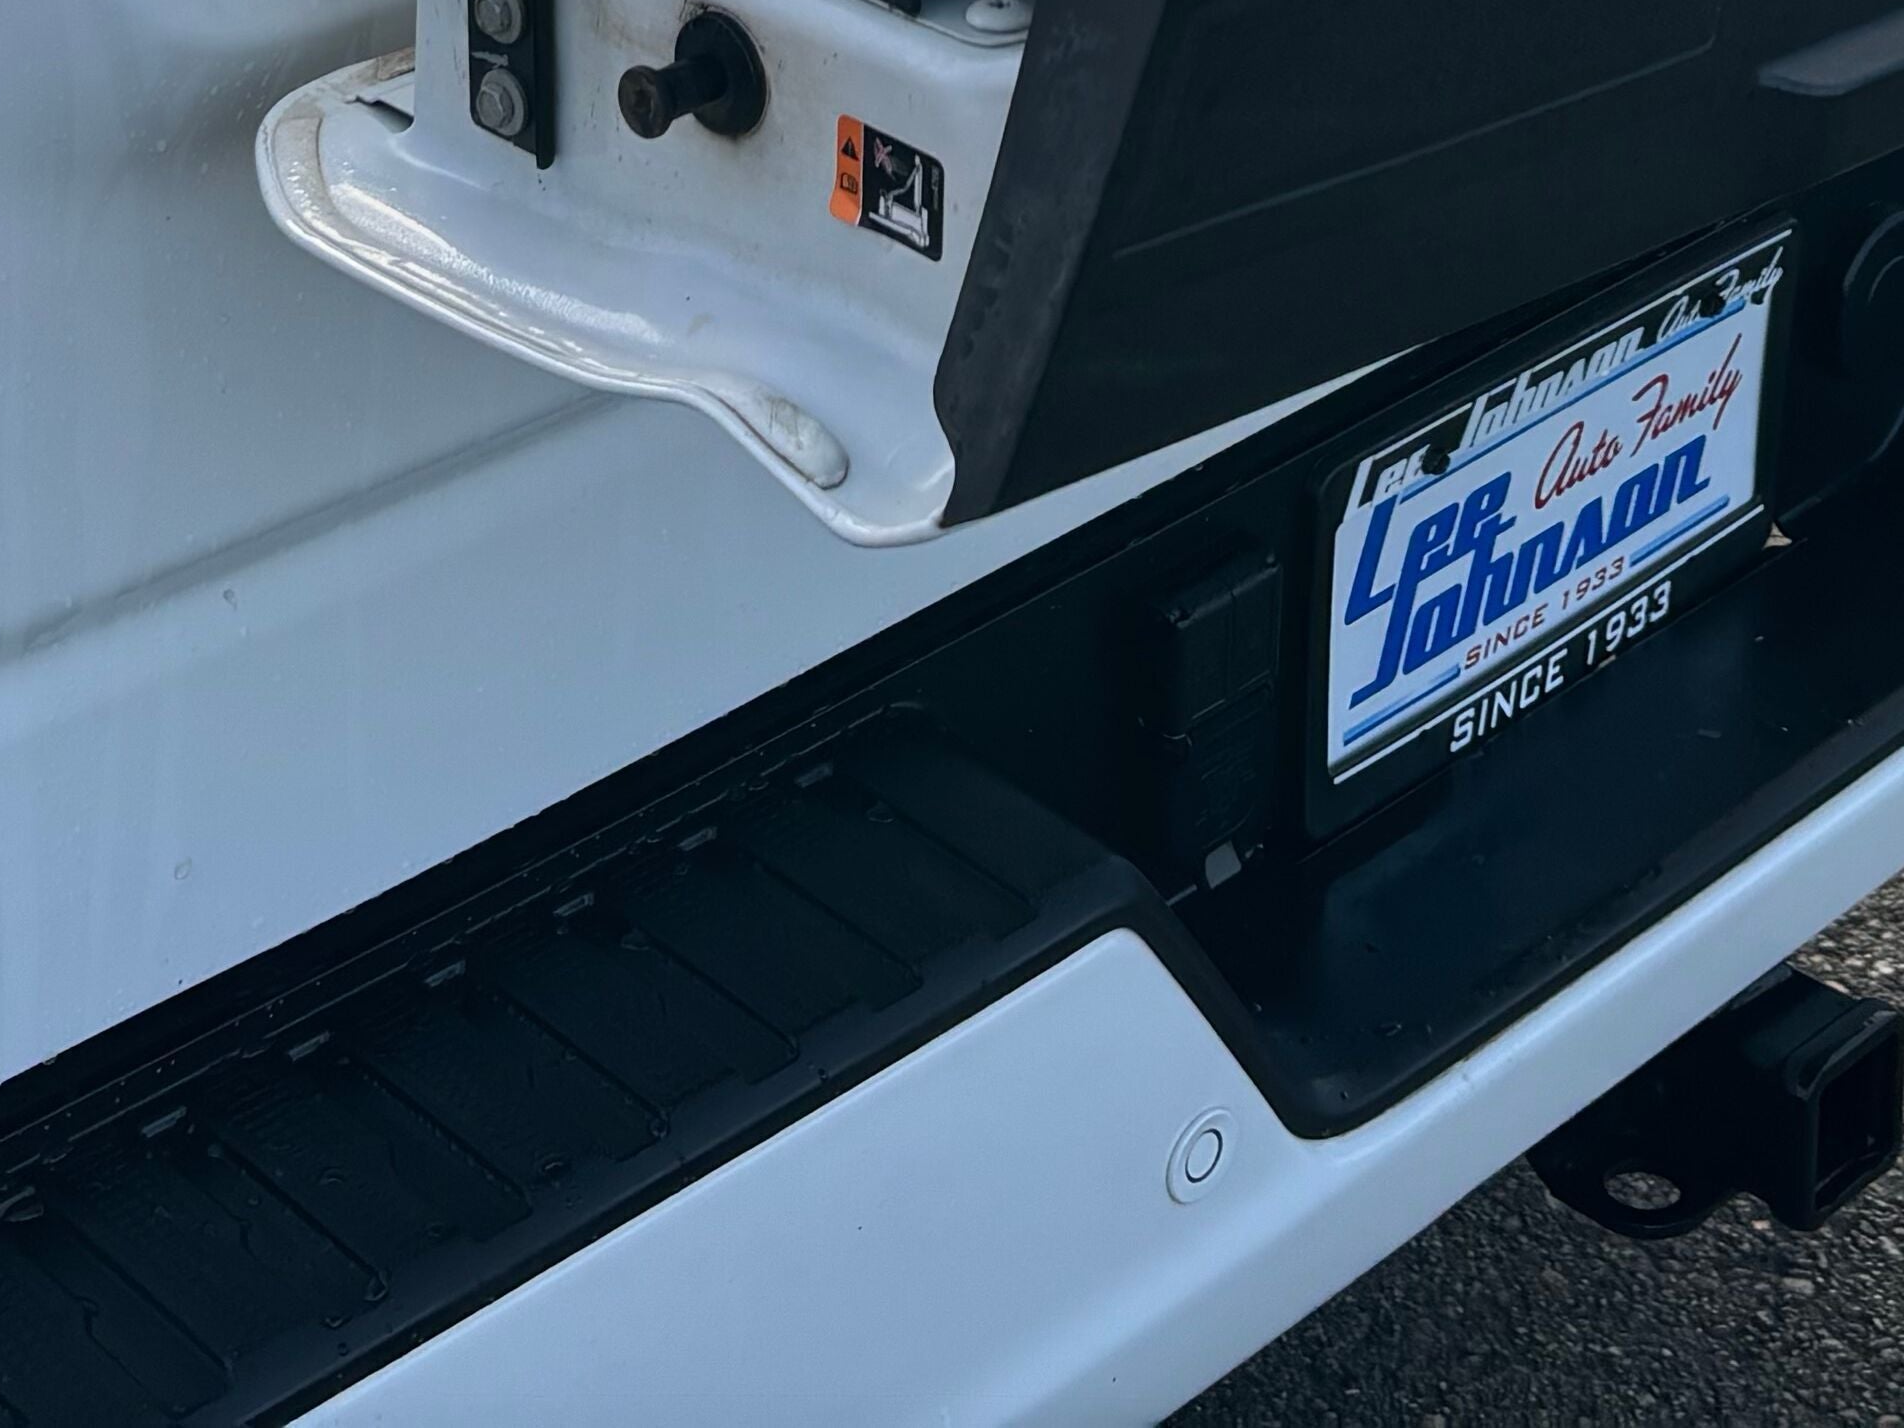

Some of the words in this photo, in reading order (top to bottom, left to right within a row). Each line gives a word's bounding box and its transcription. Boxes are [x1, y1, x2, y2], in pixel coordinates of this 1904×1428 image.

[1458, 326, 1645, 449] Johnson
[1715, 245, 1785, 306] Family
[1534, 420, 1624, 510] Auto
[1629, 332, 1743, 458] Family
[1344, 470, 1515, 625] Lee
[1348, 433, 1711, 710] Johnson
[1464, 602, 1549, 671] SINCE
[1561, 555, 1625, 611] 1933
[1449, 647, 1569, 753] SINCE
[1586, 579, 1671, 666] 1933
